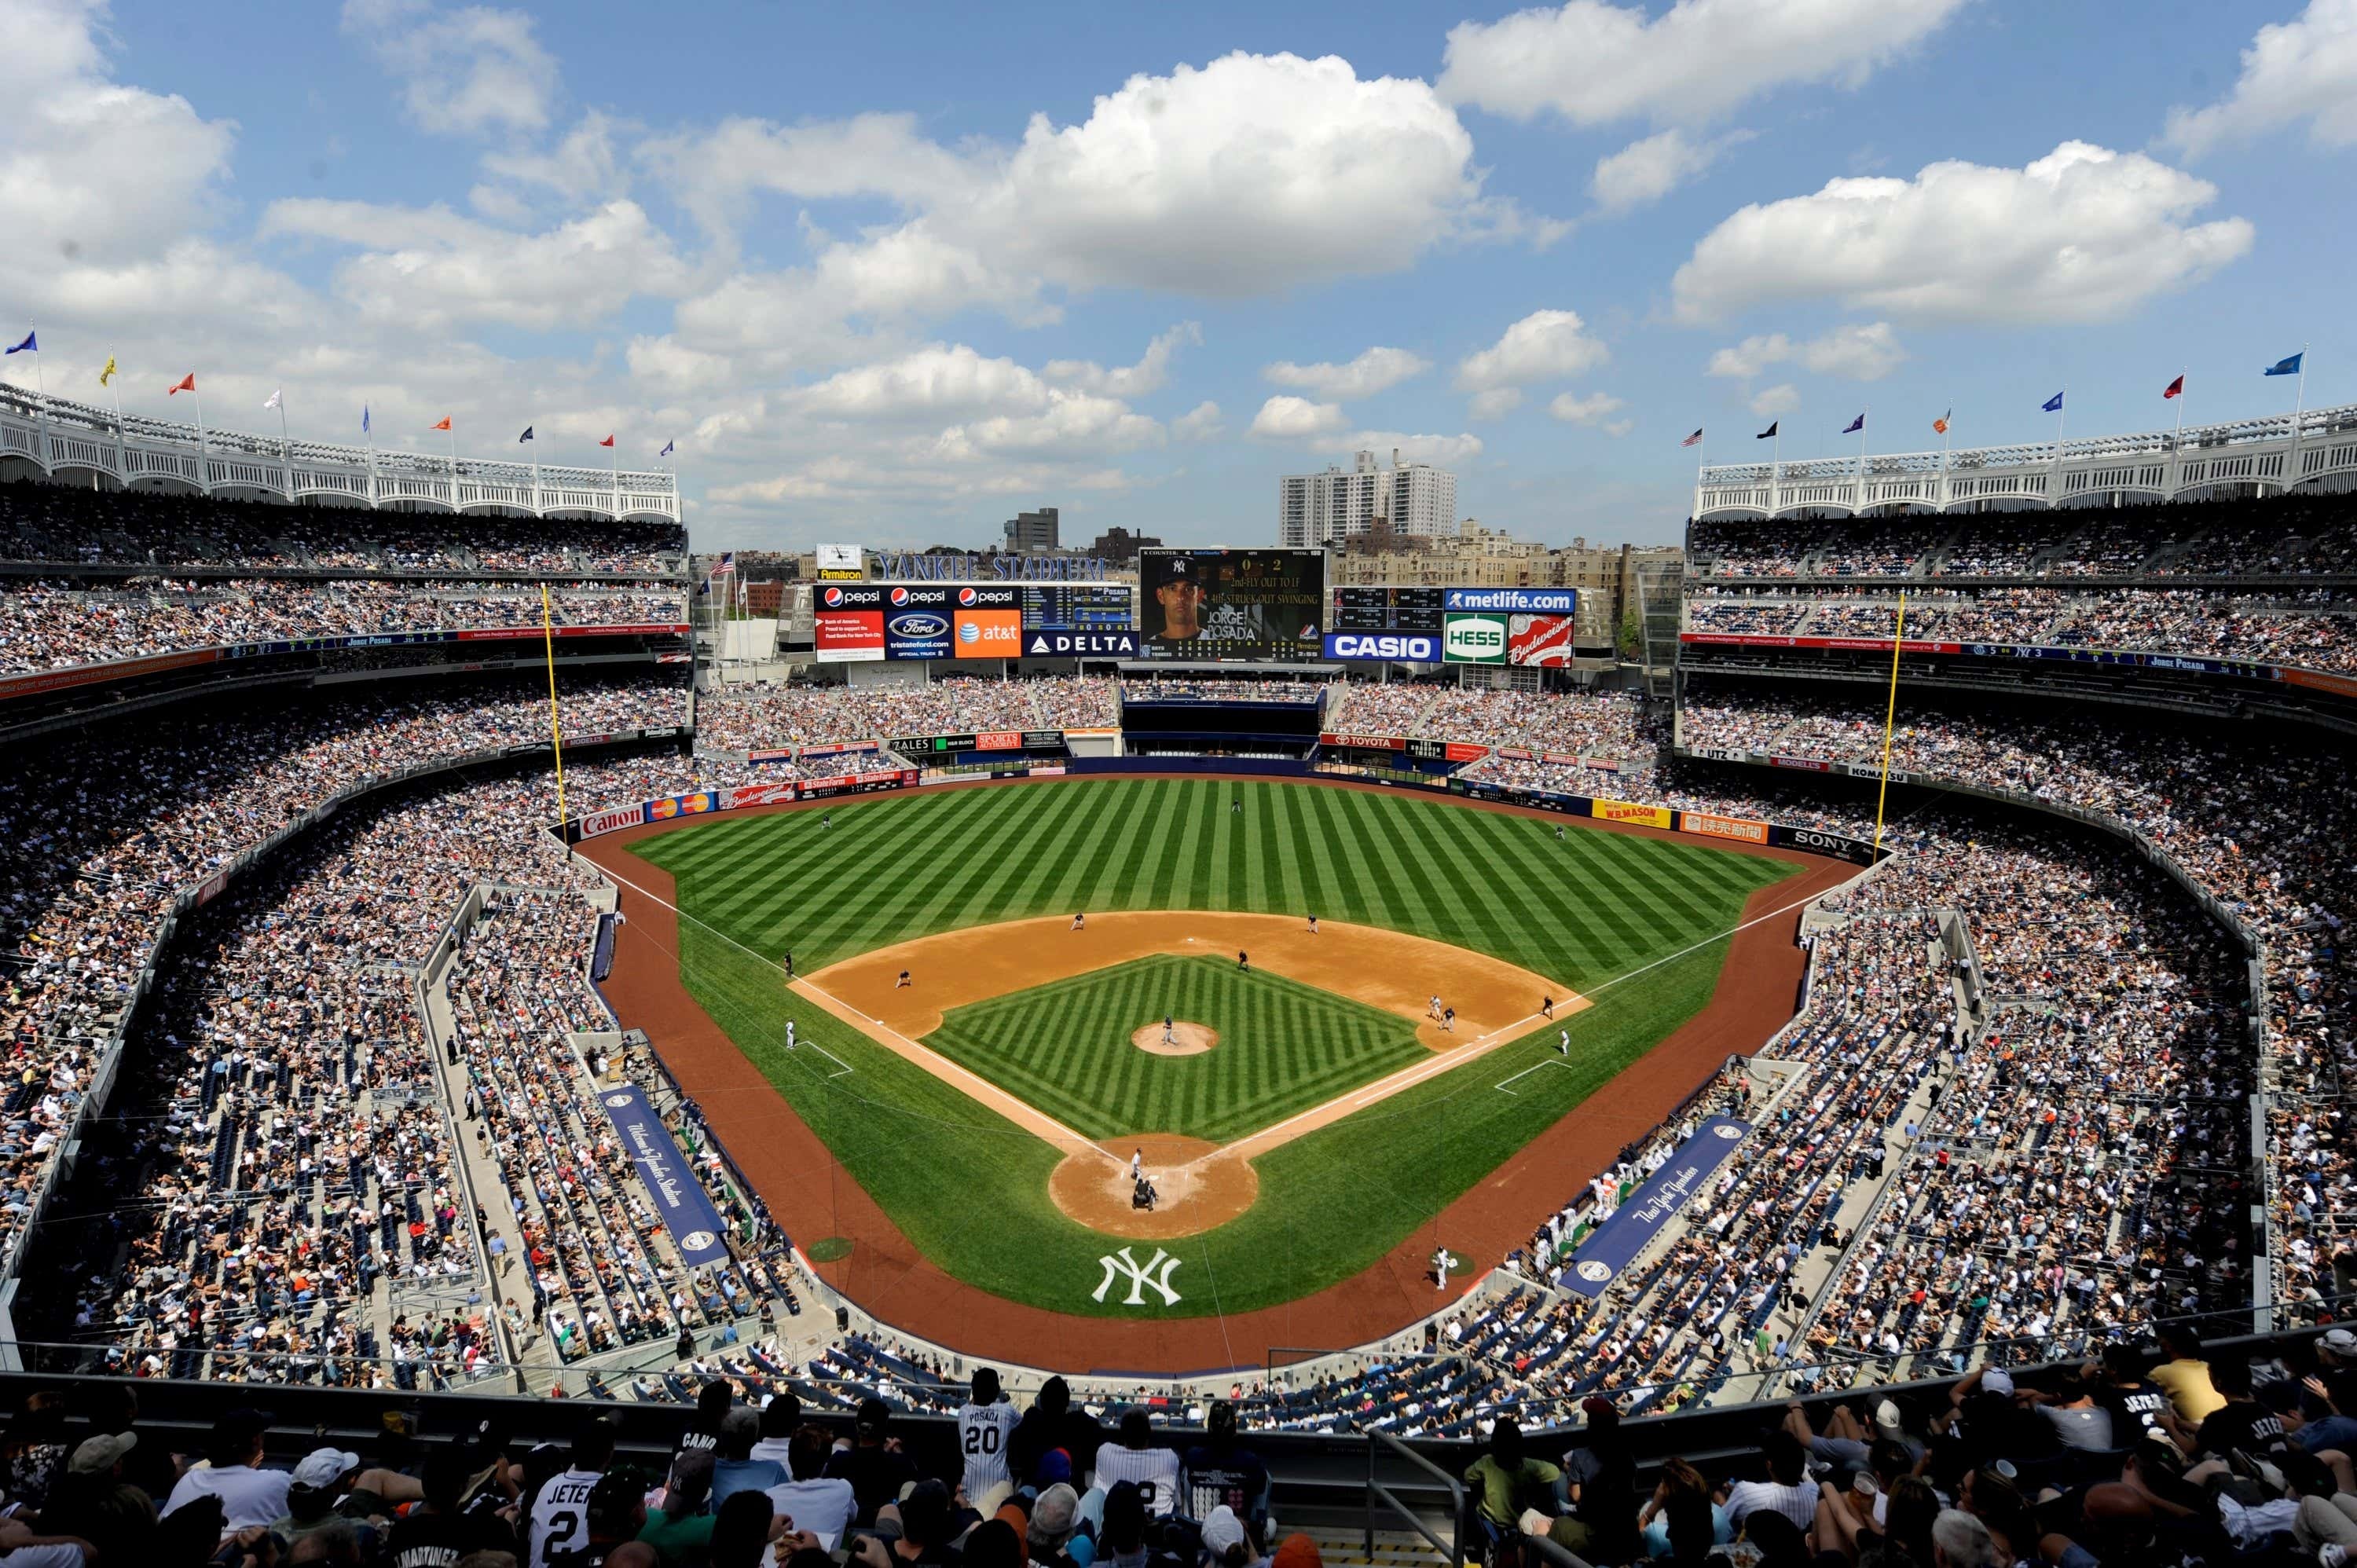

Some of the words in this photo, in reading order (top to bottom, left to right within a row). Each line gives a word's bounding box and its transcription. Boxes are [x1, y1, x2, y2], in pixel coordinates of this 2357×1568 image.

[878, 556, 980, 580] YANKEE
[993, 557, 1105, 580] STADIUM
[1242, 559, 1251, 570] 0
[1272, 559, 1281, 570] 2
[821, 570, 861, 580] Armitron
[1279, 577, 1289, 587] TO
[845, 591, 880, 603] pepsi
[911, 591, 945, 603] pepsi
[977, 591, 1013, 603] pepsi
[1465, 591, 1570, 609] metlife.com
[1208, 611, 1244, 625] JORGE
[903, 619, 935, 633] Ford
[983, 625, 1017, 641] at&t
[1208, 625, 1255, 640] POSADA
[1057, 636, 1132, 651] DELTA
[1450, 631, 1501, 646] HESS
[1508, 615, 1574, 665] Budweiser
[1336, 636, 1431, 658] CASIO
[2151, 656, 2175, 668] JORGE
[2176, 658, 2206, 671] POSADA
[570, 735, 603, 746] MODELL'S
[894, 739, 929, 751] ZALES
[979, 733, 1018, 743] SPORTS
[1351, 737, 1391, 747] TOYOTA
[1707, 749, 1727, 760] UTZ
[1778, 759, 1820, 770] MODELL'S
[1852, 768, 1904, 781] KOMATSU
[812, 779, 828, 788] State
[829, 778, 845, 786] Farm
[726, 786, 783, 808] Budweiser
[583, 809, 640, 835] Canon
[1703, 819, 1761, 840] 読売新聞
[1795, 831, 1852, 852] SONY
[635, 1152, 670, 1181] Yankee
[658, 1178, 681, 1208] Stadium
[1633, 1208, 1660, 1223] New
[1648, 1184, 1675, 1211] York
[1666, 1166, 1699, 1196] Yankees
[1091, 1246, 1182, 1306] NY
[970, 1412, 999, 1423] POSADA
[683, 1433, 717, 1450] CANO
[965, 1426, 1000, 1454] 20
[542, 1511, 578, 1563] 2
